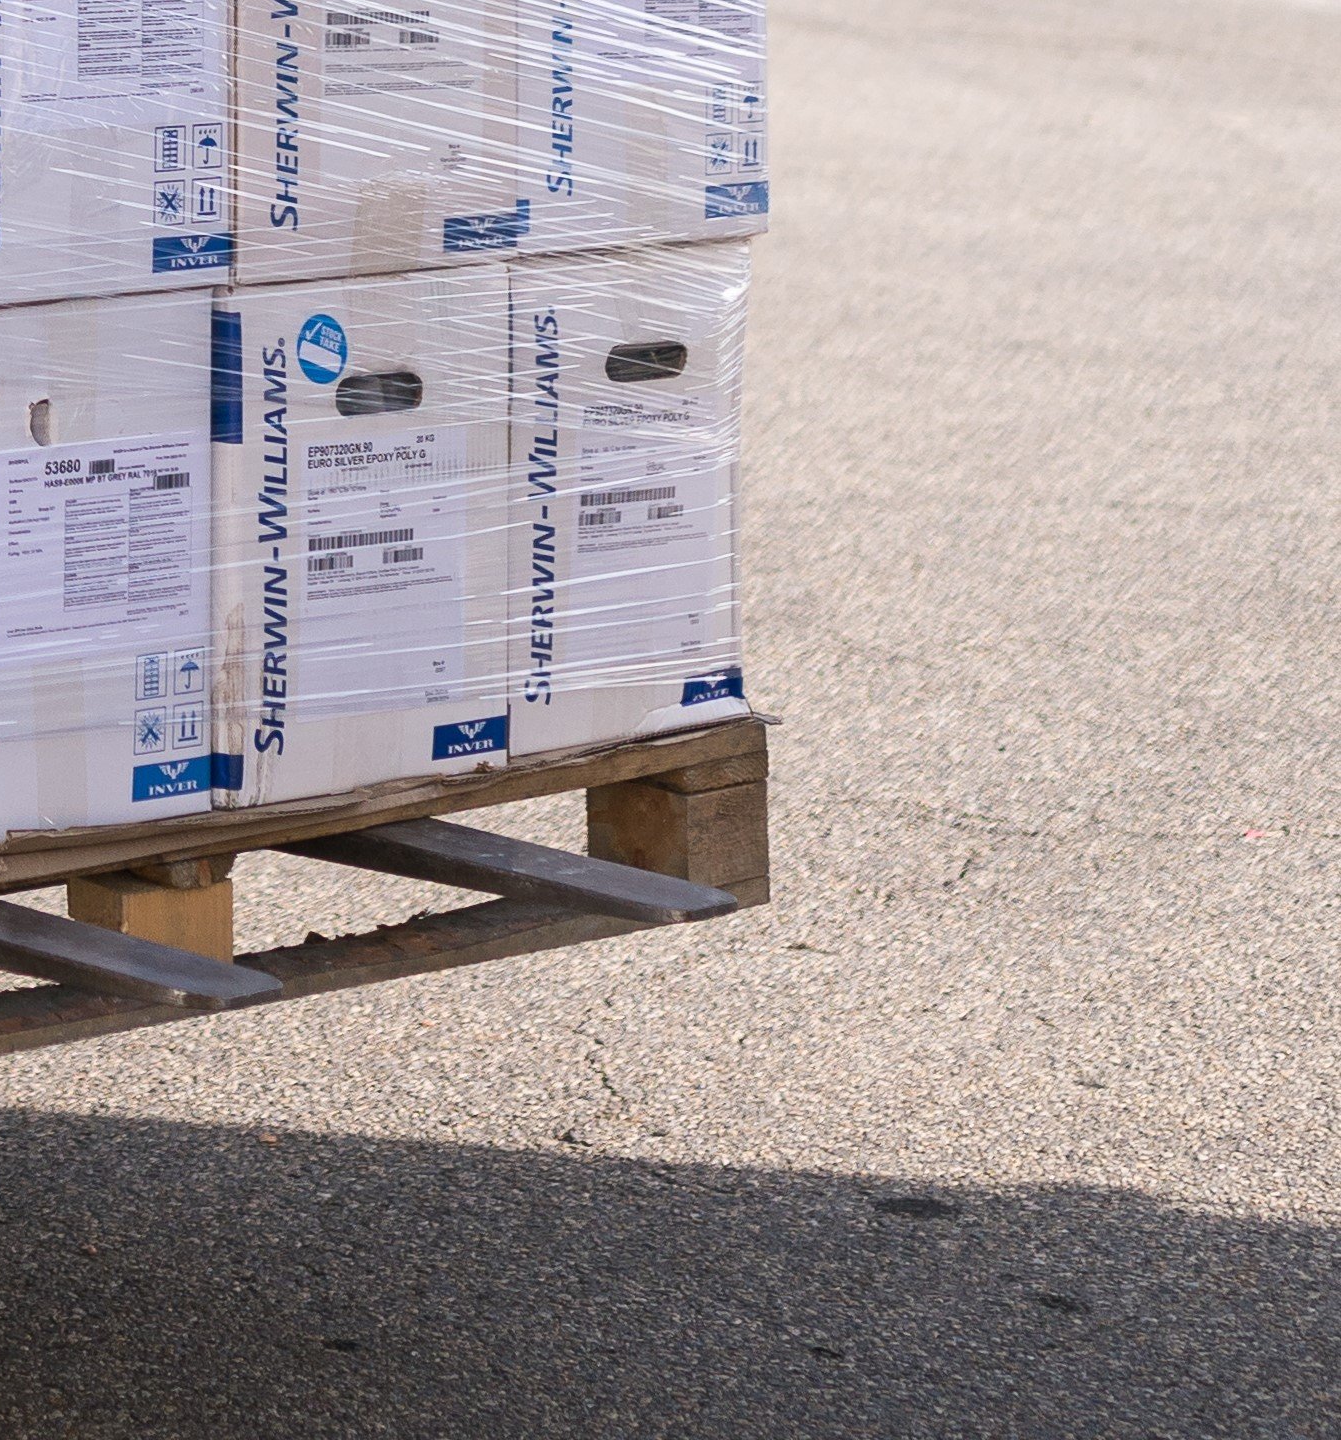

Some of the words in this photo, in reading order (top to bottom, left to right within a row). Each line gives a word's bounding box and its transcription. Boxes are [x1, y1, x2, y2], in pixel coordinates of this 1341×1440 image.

[320, 335, 340, 353] TAKE
[424, 434, 435, 443] KG
[44, 459, 81, 476] 53680
[307, 458, 333, 469] EURO
[334, 455, 365, 467] SILVER
[366, 453, 394, 464] EPOXY
[395, 450, 418, 461] POLY
[419, 449, 426, 459] G
[85, 475, 96, 484] MP
[108, 472, 126, 482] GREY
[127, 471, 141, 480] RAL
[448, 738, 493, 755] INVER
[148, 779, 198, 796] INVER
